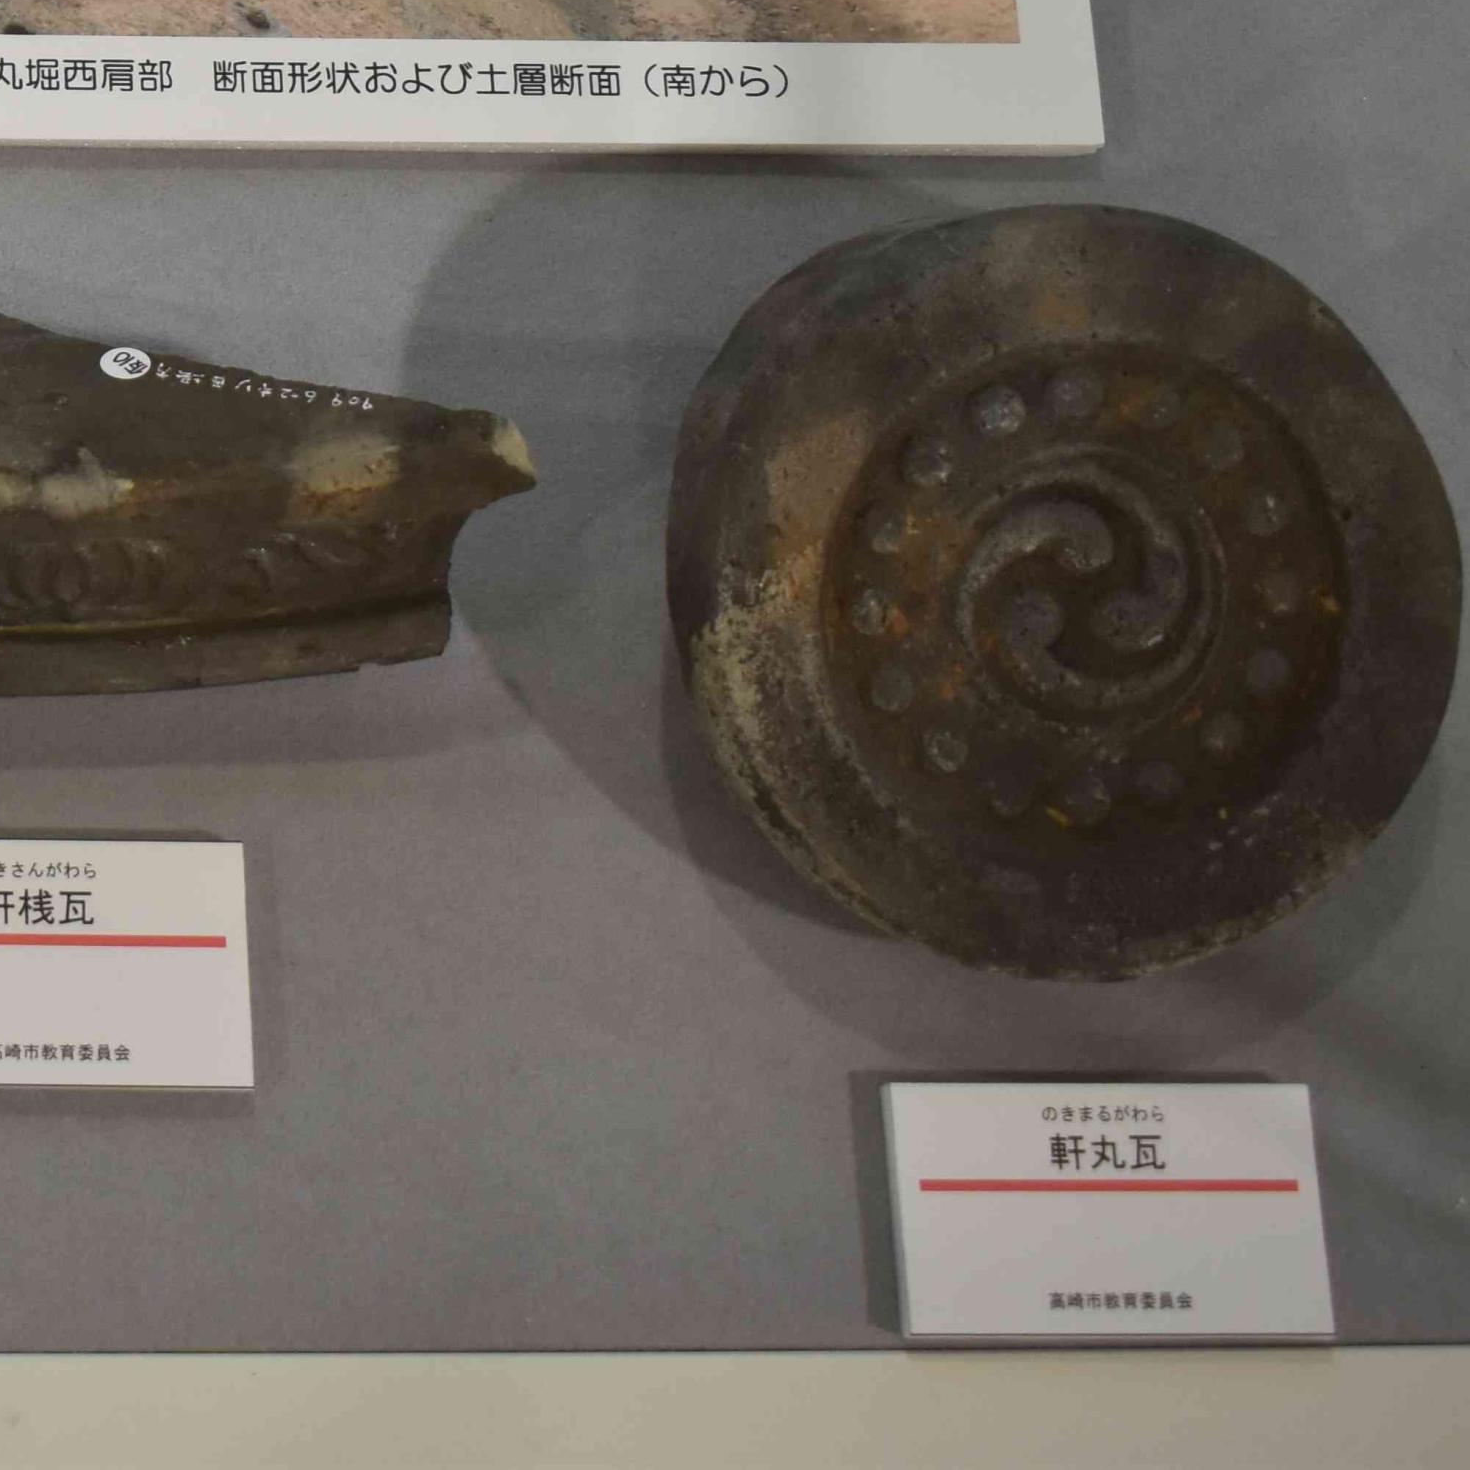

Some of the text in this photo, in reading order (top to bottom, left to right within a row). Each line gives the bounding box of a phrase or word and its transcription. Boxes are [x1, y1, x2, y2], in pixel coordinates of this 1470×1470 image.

[213, 60, 789, 99] 断面形状および土層断面（南から）
[1042, 1105, 1164, 1123] のきまるがわら
[1050, 1133, 1166, 1170] 軒丸瓦
[1050, 1292, 1192, 1310] 高崎市教育委員会
